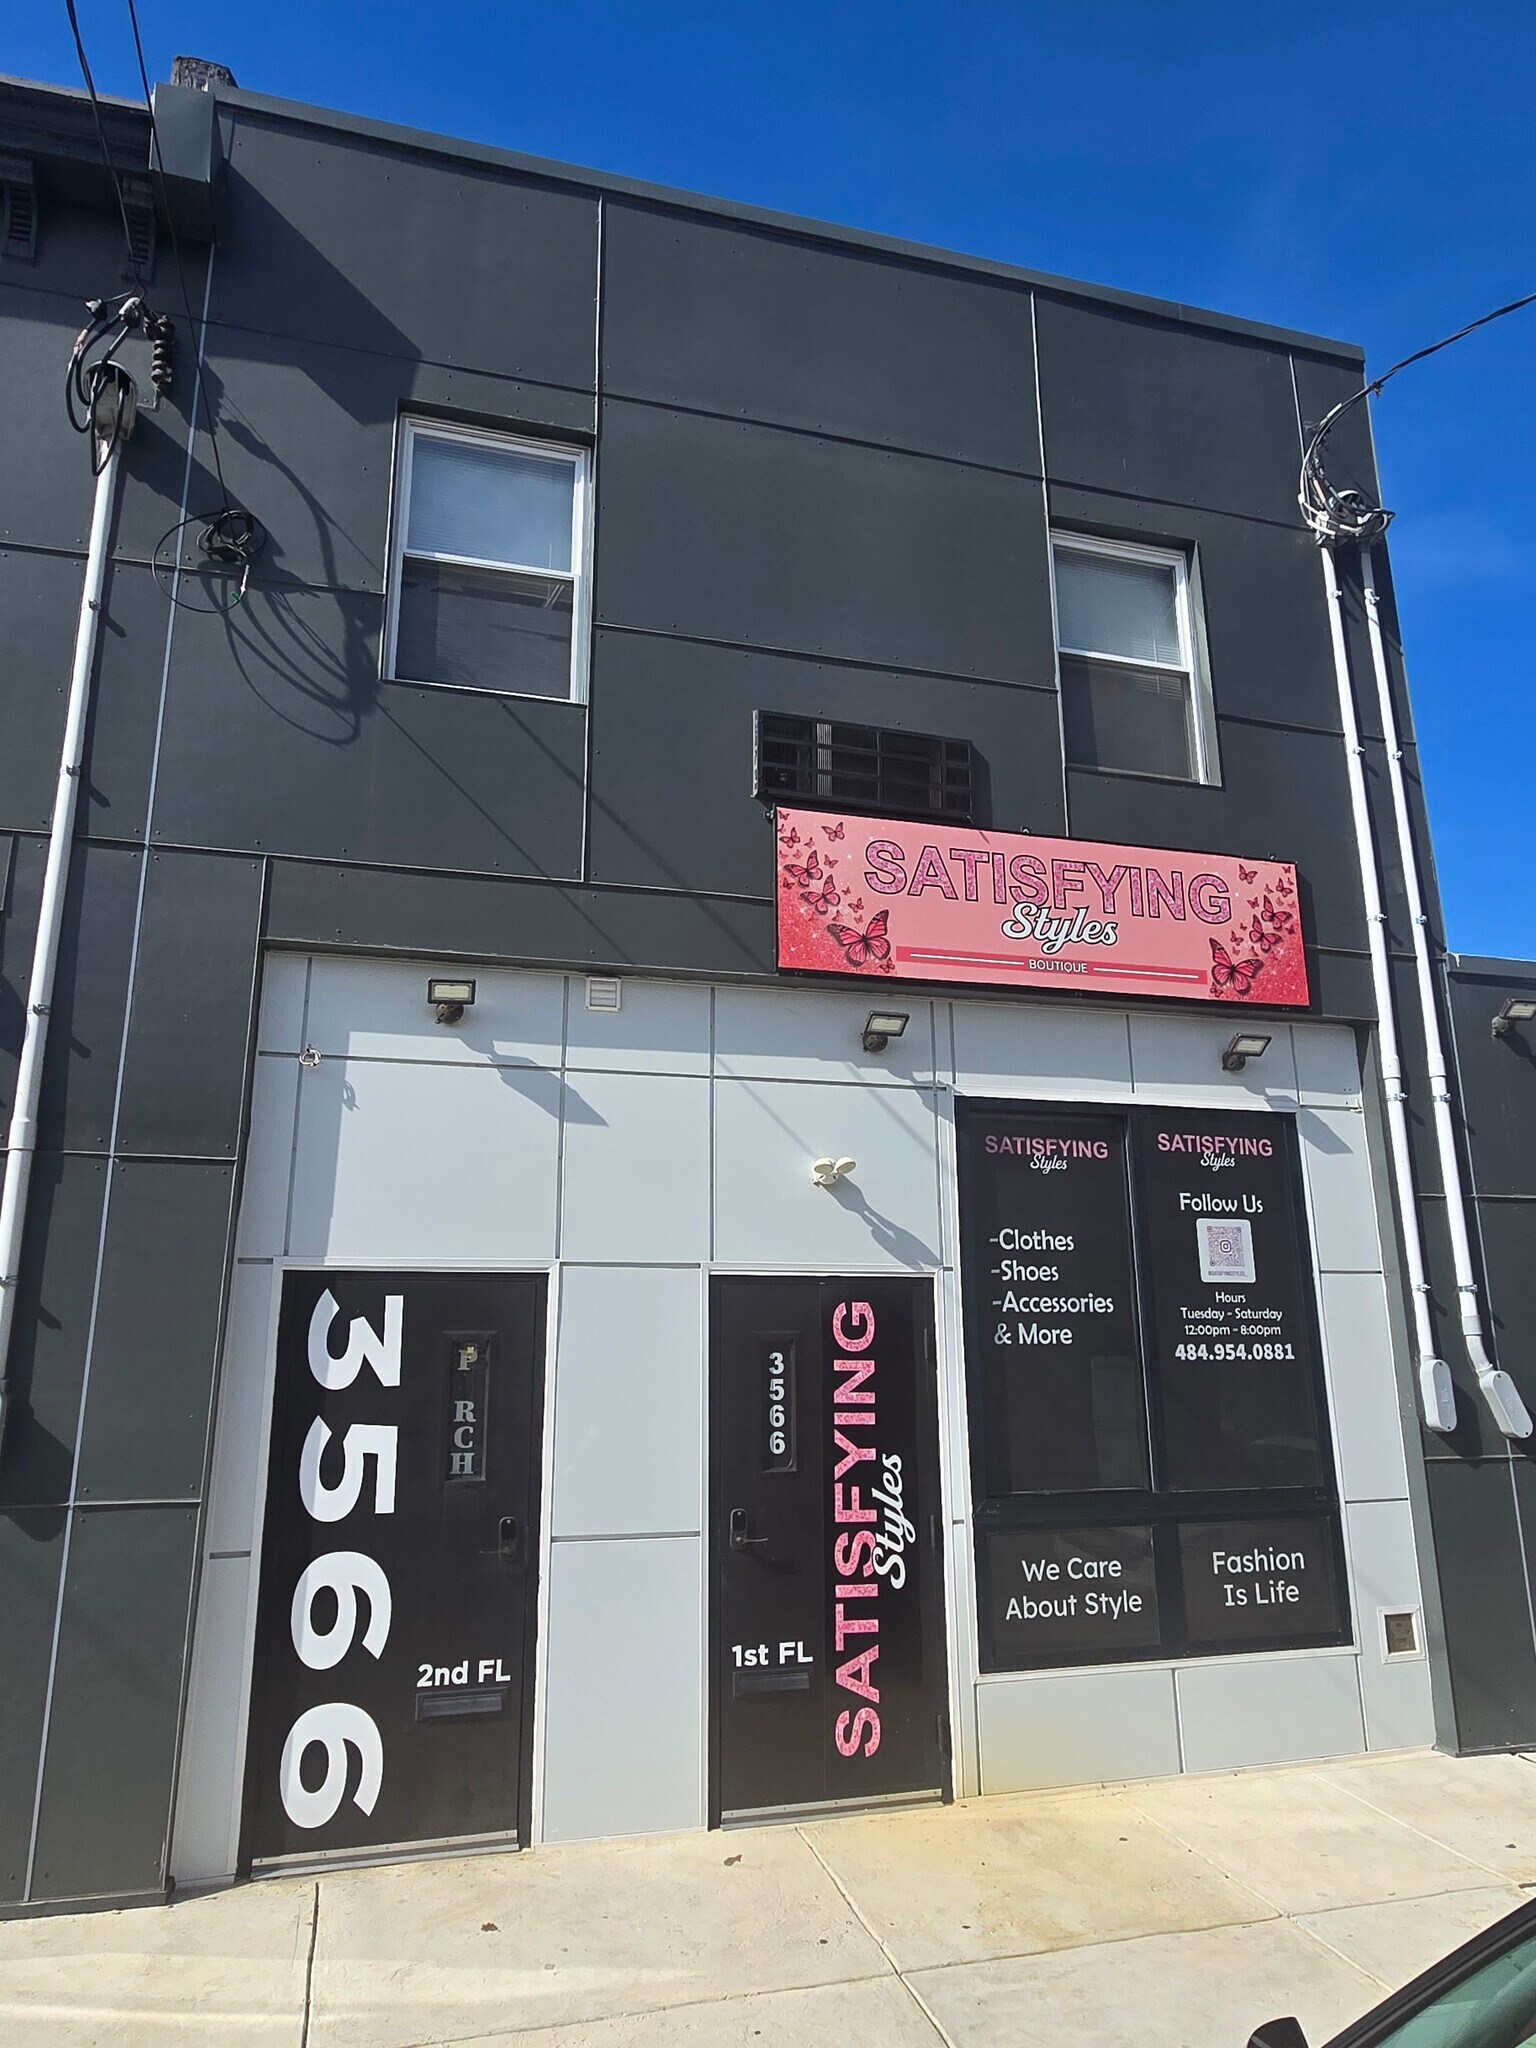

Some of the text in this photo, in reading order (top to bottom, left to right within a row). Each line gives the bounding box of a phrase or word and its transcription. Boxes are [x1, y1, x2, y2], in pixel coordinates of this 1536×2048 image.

[864, 840, 1232, 925] SATISFYING
[1001, 901, 1118, 954] Styles
[1028, 958, 1088, 974] BOUTIQUE
[985, 1135, 1109, 1159] SATISFYING
[1157, 1133, 1273, 1156] SATISFYING
[1030, 1154, 1068, 1174] Styles
[1200, 1151, 1236, 1172] Styles
[1179, 1192, 1264, 1213] Follow Us
[989, 1228, 1075, 1251] -Clothes
[991, 1260, 1060, 1282] -Shoes
[992, 1291, 1114, 1314] -Accessories
[1215, 1291, 1247, 1303] Hours
[1180, 1307, 1225, 1322] Tuesday
[1235, 1308, 1283, 1322] Saturday
[994, 1323, 1073, 1345] & More
[1184, 1325, 1231, 1338] 12:00pm
[1240, 1325, 1281, 1338] 8:00pm
[1175, 1343, 1295, 1360] 484.954.0881
[768, 1351, 786, 1455] 3566
[832, 1301, 881, 1758] SATISFYING
[871, 1454, 916, 1590] Styles
[280, 1288, 404, 1829] 3566
[1021, 1557, 1122, 1582] We Care
[1212, 1547, 1305, 1575] Fashion
[1005, 1589, 1143, 1620] About Style
[1223, 1580, 1300, 1607] Is Life
[732, 1642, 813, 1667] 1st FL
[417, 1659, 511, 1688] 2nd FL
